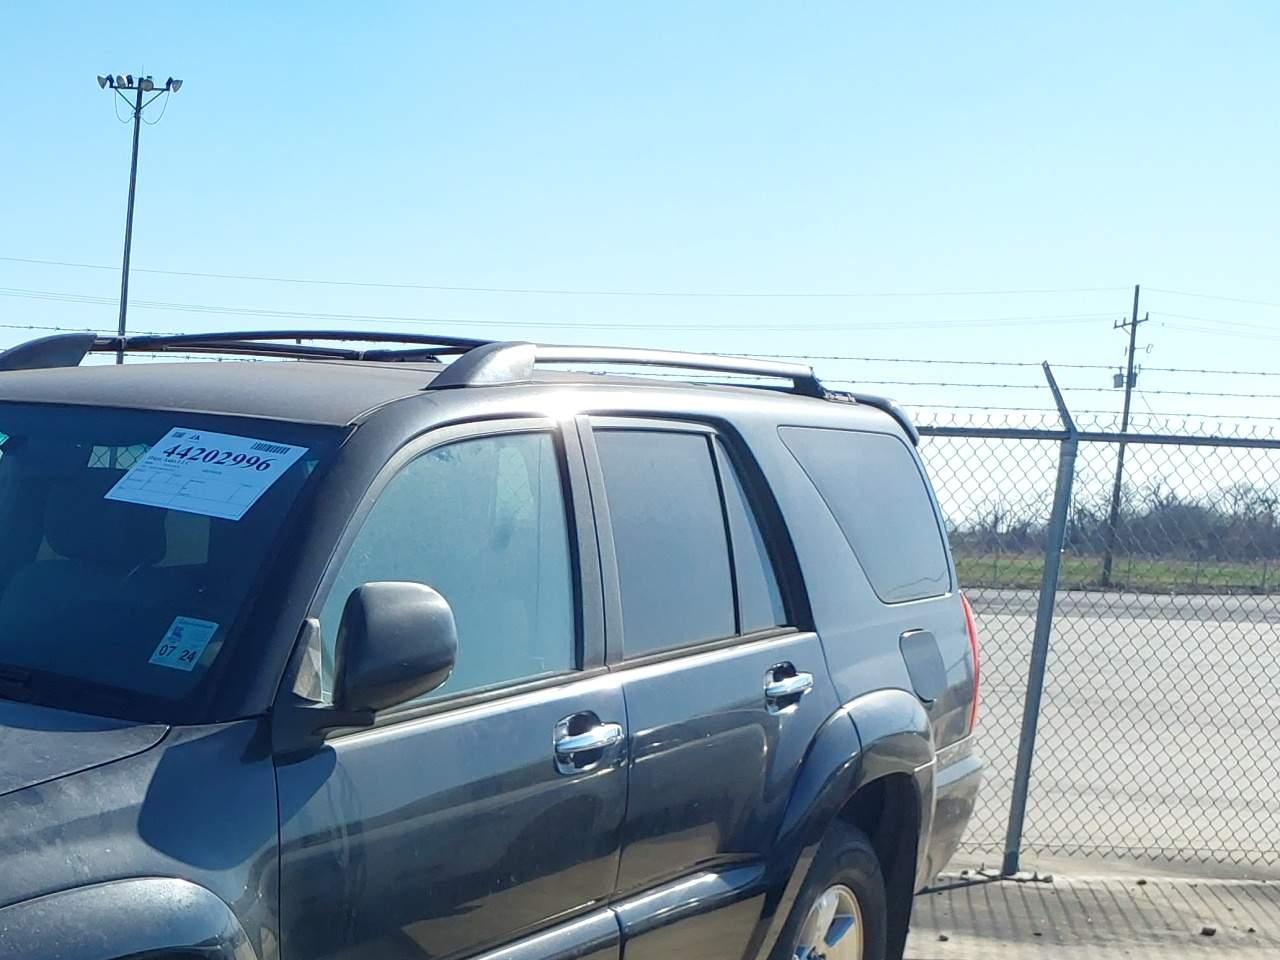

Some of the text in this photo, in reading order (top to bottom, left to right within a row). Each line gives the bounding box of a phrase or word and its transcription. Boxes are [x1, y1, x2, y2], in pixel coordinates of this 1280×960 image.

[162, 444, 277, 472] 44202996
[159, 645, 197, 663] 07 24
